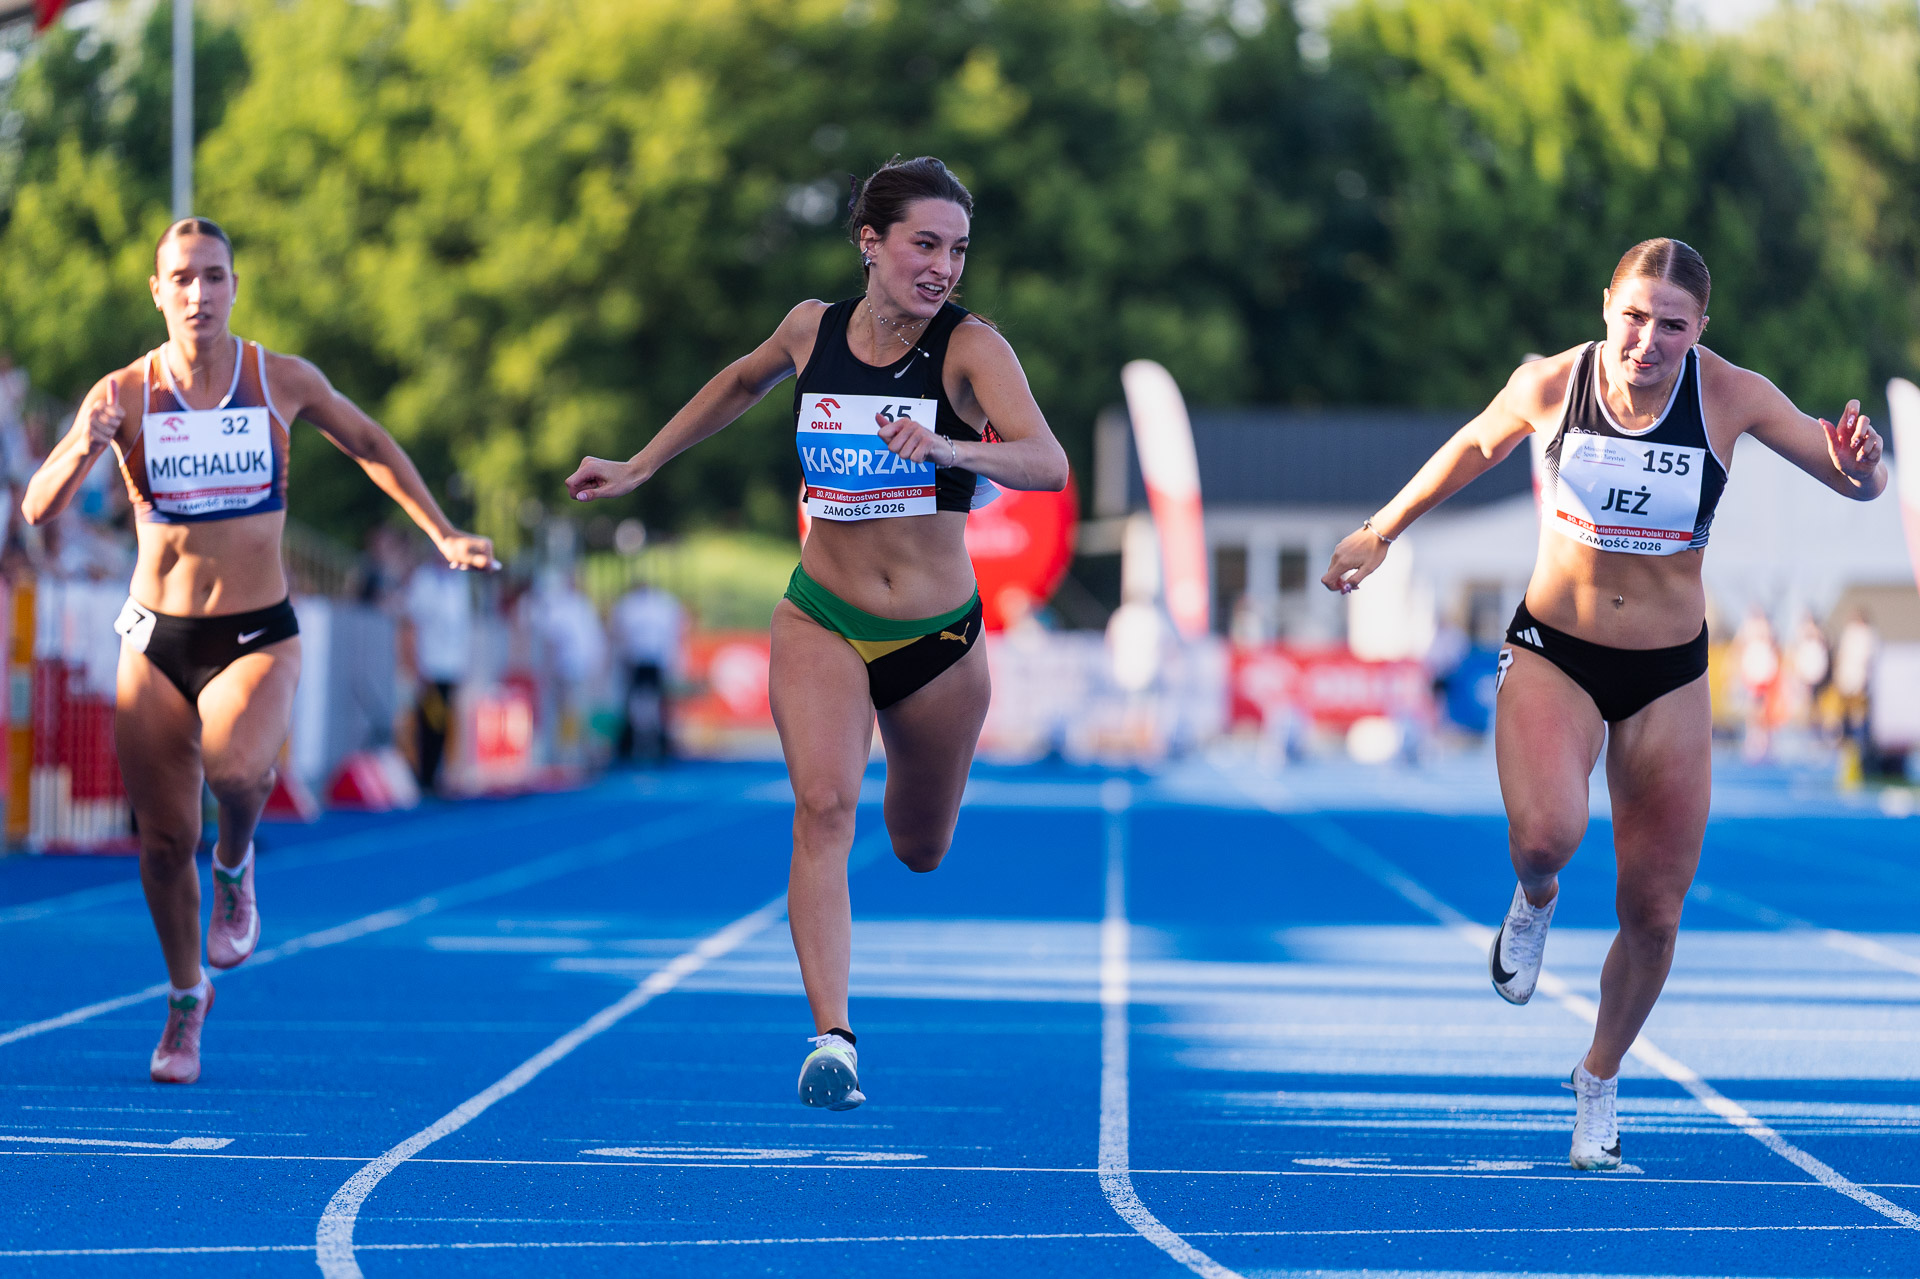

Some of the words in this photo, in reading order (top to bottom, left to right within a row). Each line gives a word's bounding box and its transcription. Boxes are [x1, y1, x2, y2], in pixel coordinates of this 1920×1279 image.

[222, 416, 249, 435] 32
[811, 421, 842, 430] ORLEN
[151, 450, 266, 480] MICHALUK
[1642, 450, 1690, 476] 155
[816, 490, 824, 499] 80.
[825, 492, 836, 500] PZLA
[837, 493, 879, 502] Mistrzostwa
[881, 490, 905, 498] Polski
[906, 489, 922, 497] U20
[1601, 485, 1651, 516] JEŻ
[823, 504, 871, 516] ZAMOŚĆ
[874, 503, 905, 514] 2026
[1567, 515, 1577, 525] 80.
[1579, 519, 1594, 532] PZLA
[1596, 526, 1640, 537] Mistrzostwa
[1642, 530, 1664, 538] Polski
[1665, 532, 1680, 540] U20
[1579, 532, 1629, 549] ZAMOŚĆ
[1633, 541, 1661, 551] 2026
